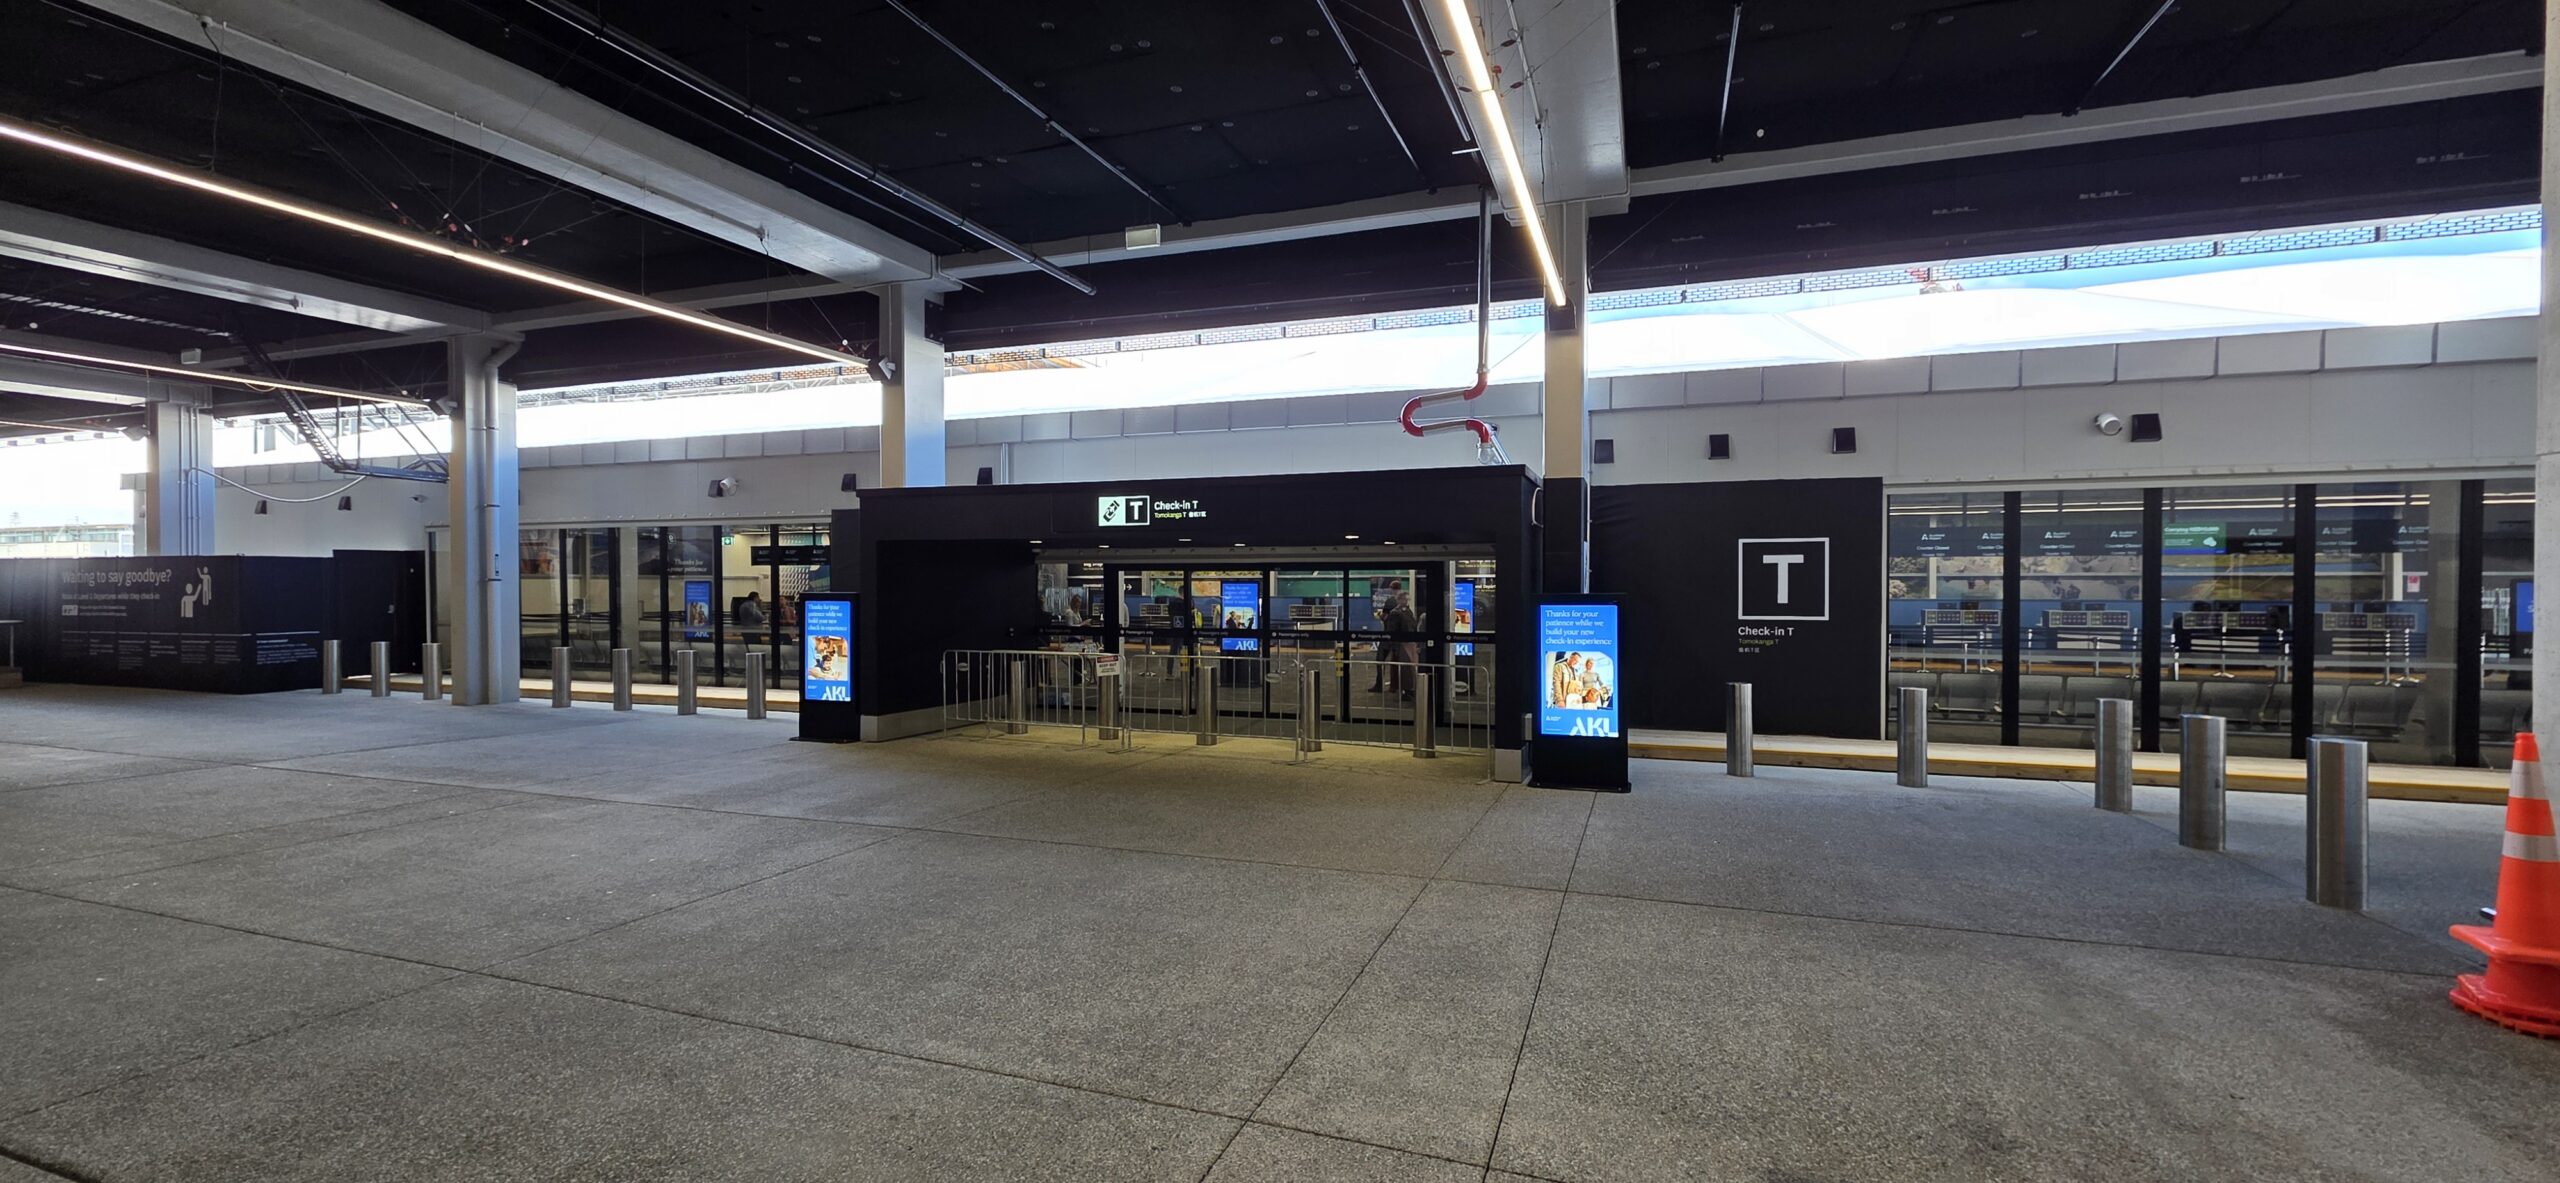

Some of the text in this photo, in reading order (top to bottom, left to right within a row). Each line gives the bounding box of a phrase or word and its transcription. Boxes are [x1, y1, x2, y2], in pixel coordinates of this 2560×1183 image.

[1154, 500, 1198, 510] Check-in T
[1130, 501, 1143, 520] T
[62, 568, 172, 586] Waiting to say goodbye?
[1762, 554, 1804, 604] T
[1545, 610, 1570, 618] Thanks
[1575, 619, 1593, 627] while
[1738, 626, 1794, 636] Check-in T
[1235, 640, 1258, 650] AKL
[1546, 637, 1574, 645] check-in
[1455, 644, 1472, 655] KL
[821, 685, 851, 701] AKL
[1569, 716, 1620, 738] AKL
